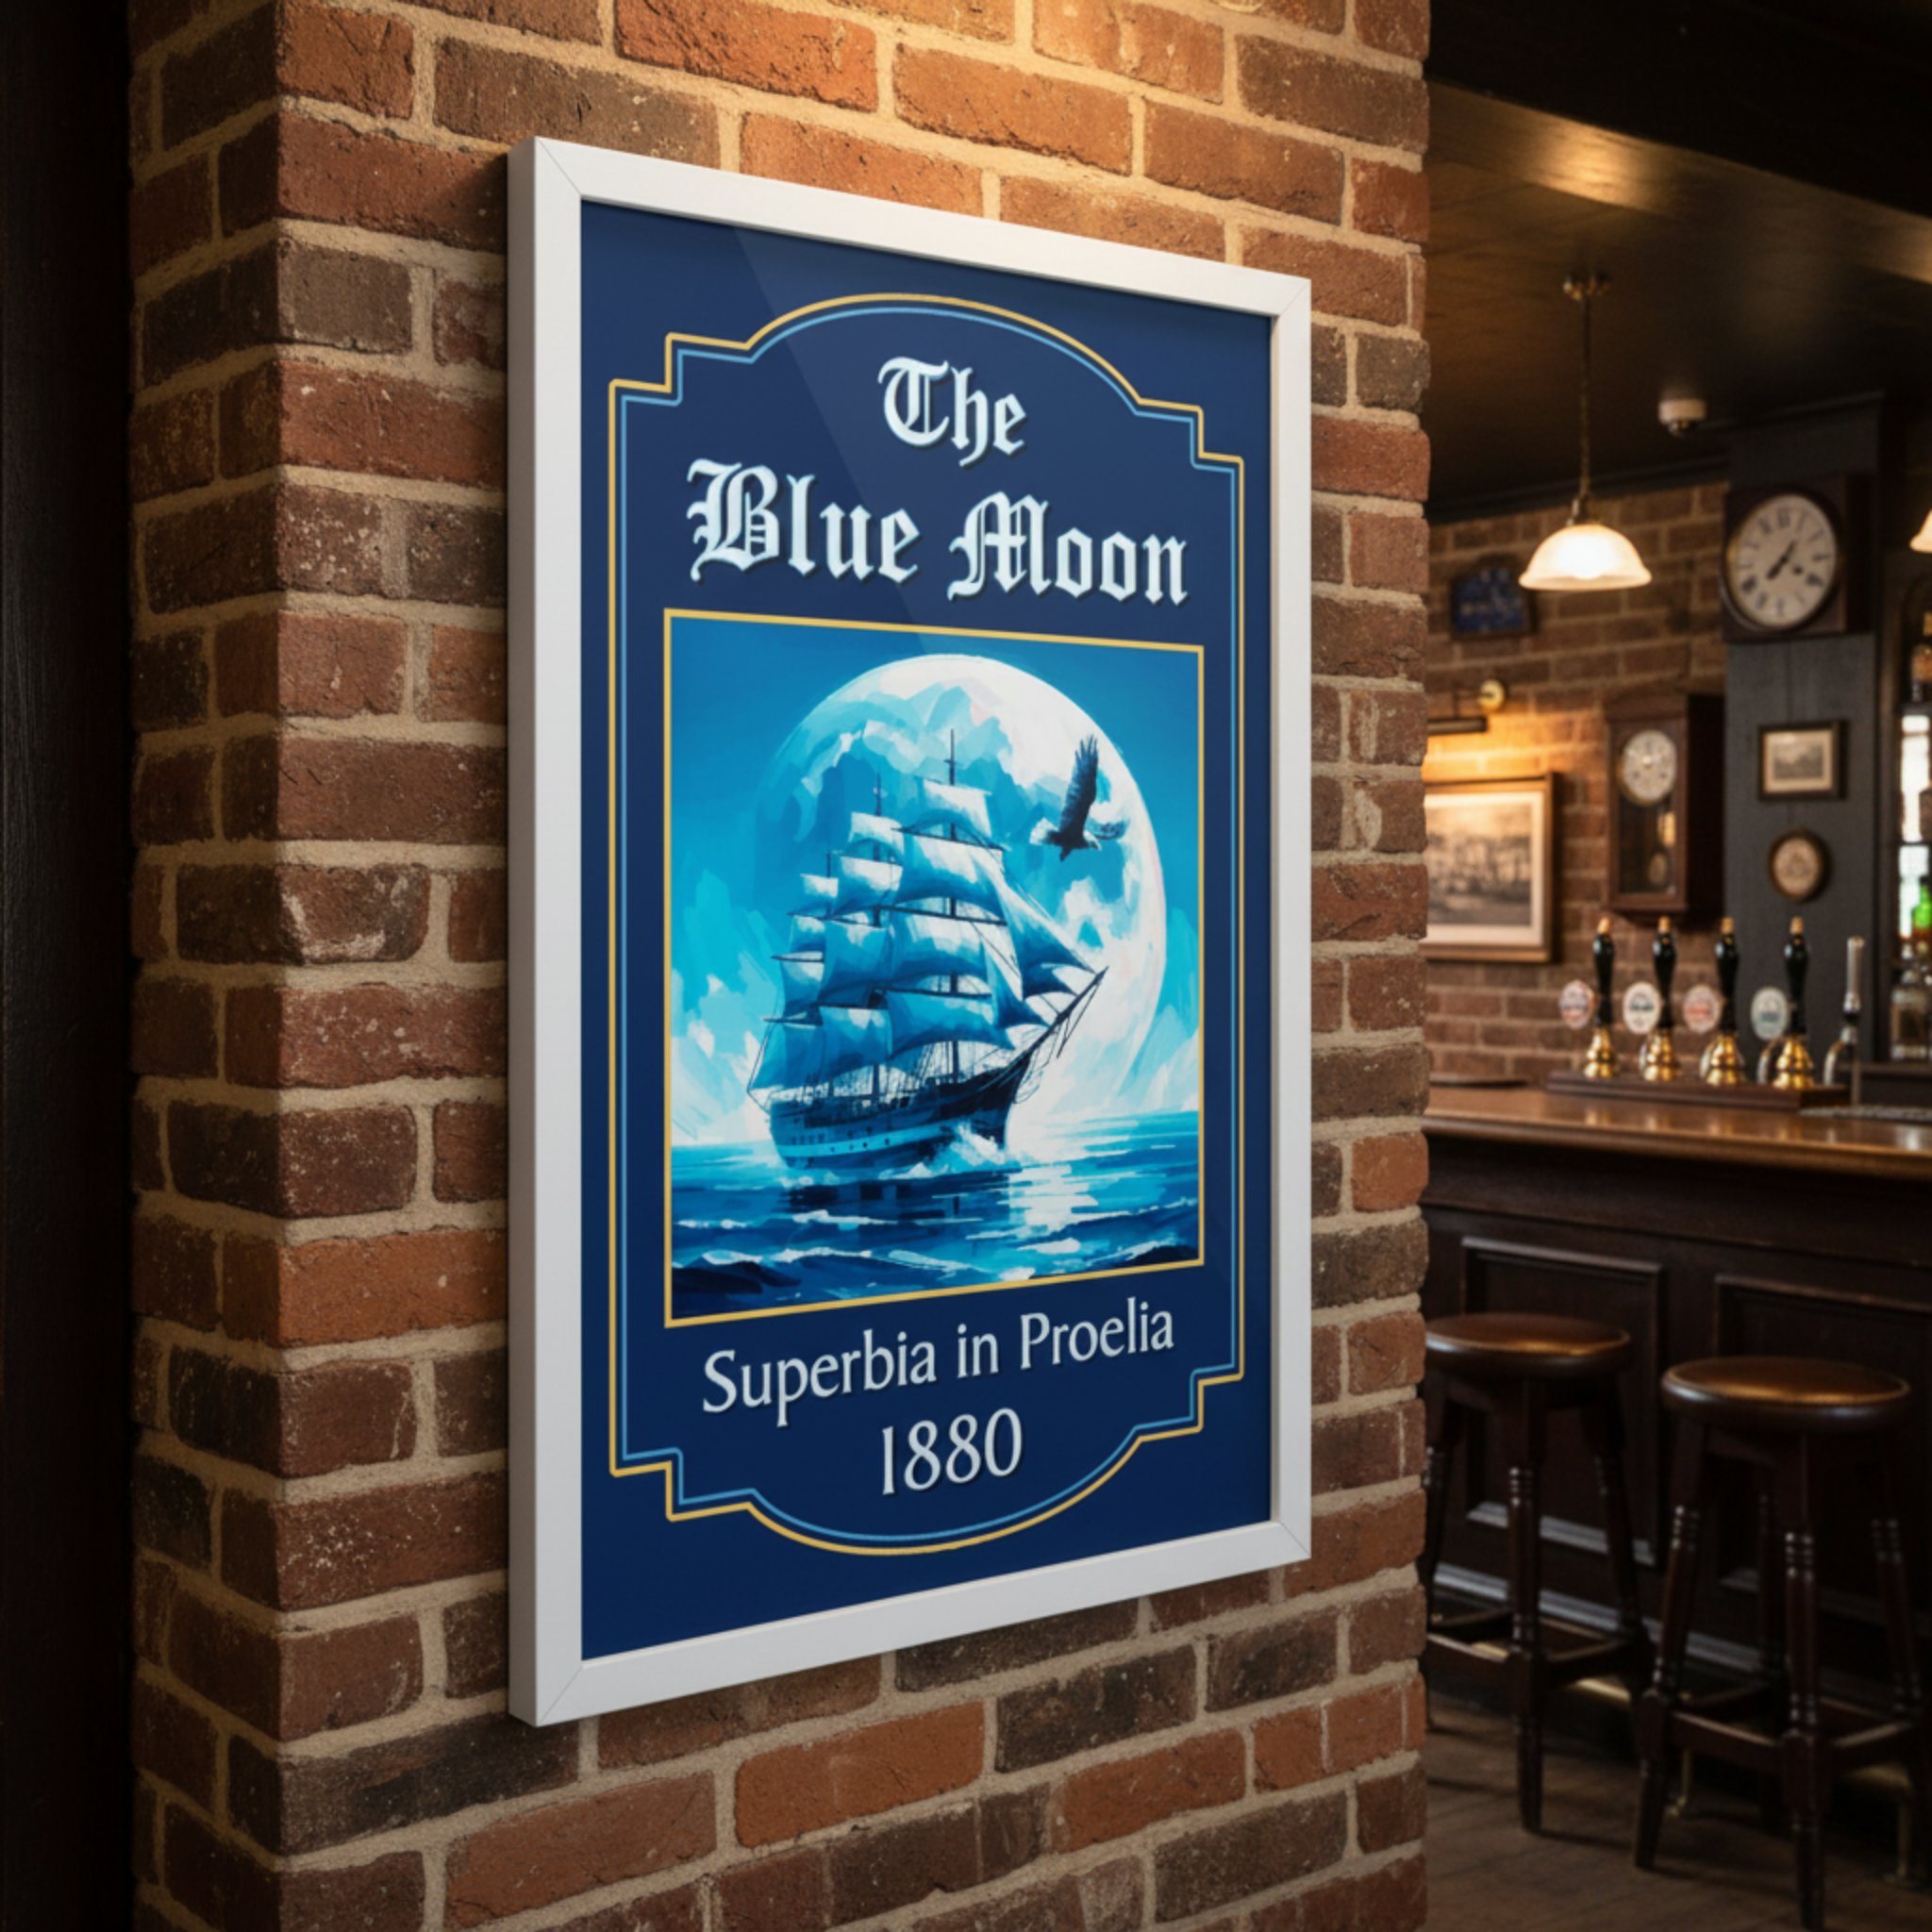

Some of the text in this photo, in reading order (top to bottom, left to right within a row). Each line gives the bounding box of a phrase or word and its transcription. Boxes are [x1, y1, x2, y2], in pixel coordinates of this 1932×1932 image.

[877, 357, 1027, 467] The
[686, 458, 1189, 607] Blue Moon
[702, 1296, 1174, 1427] Superbia in Proelia
[882, 1407, 1023, 1495] 1880
